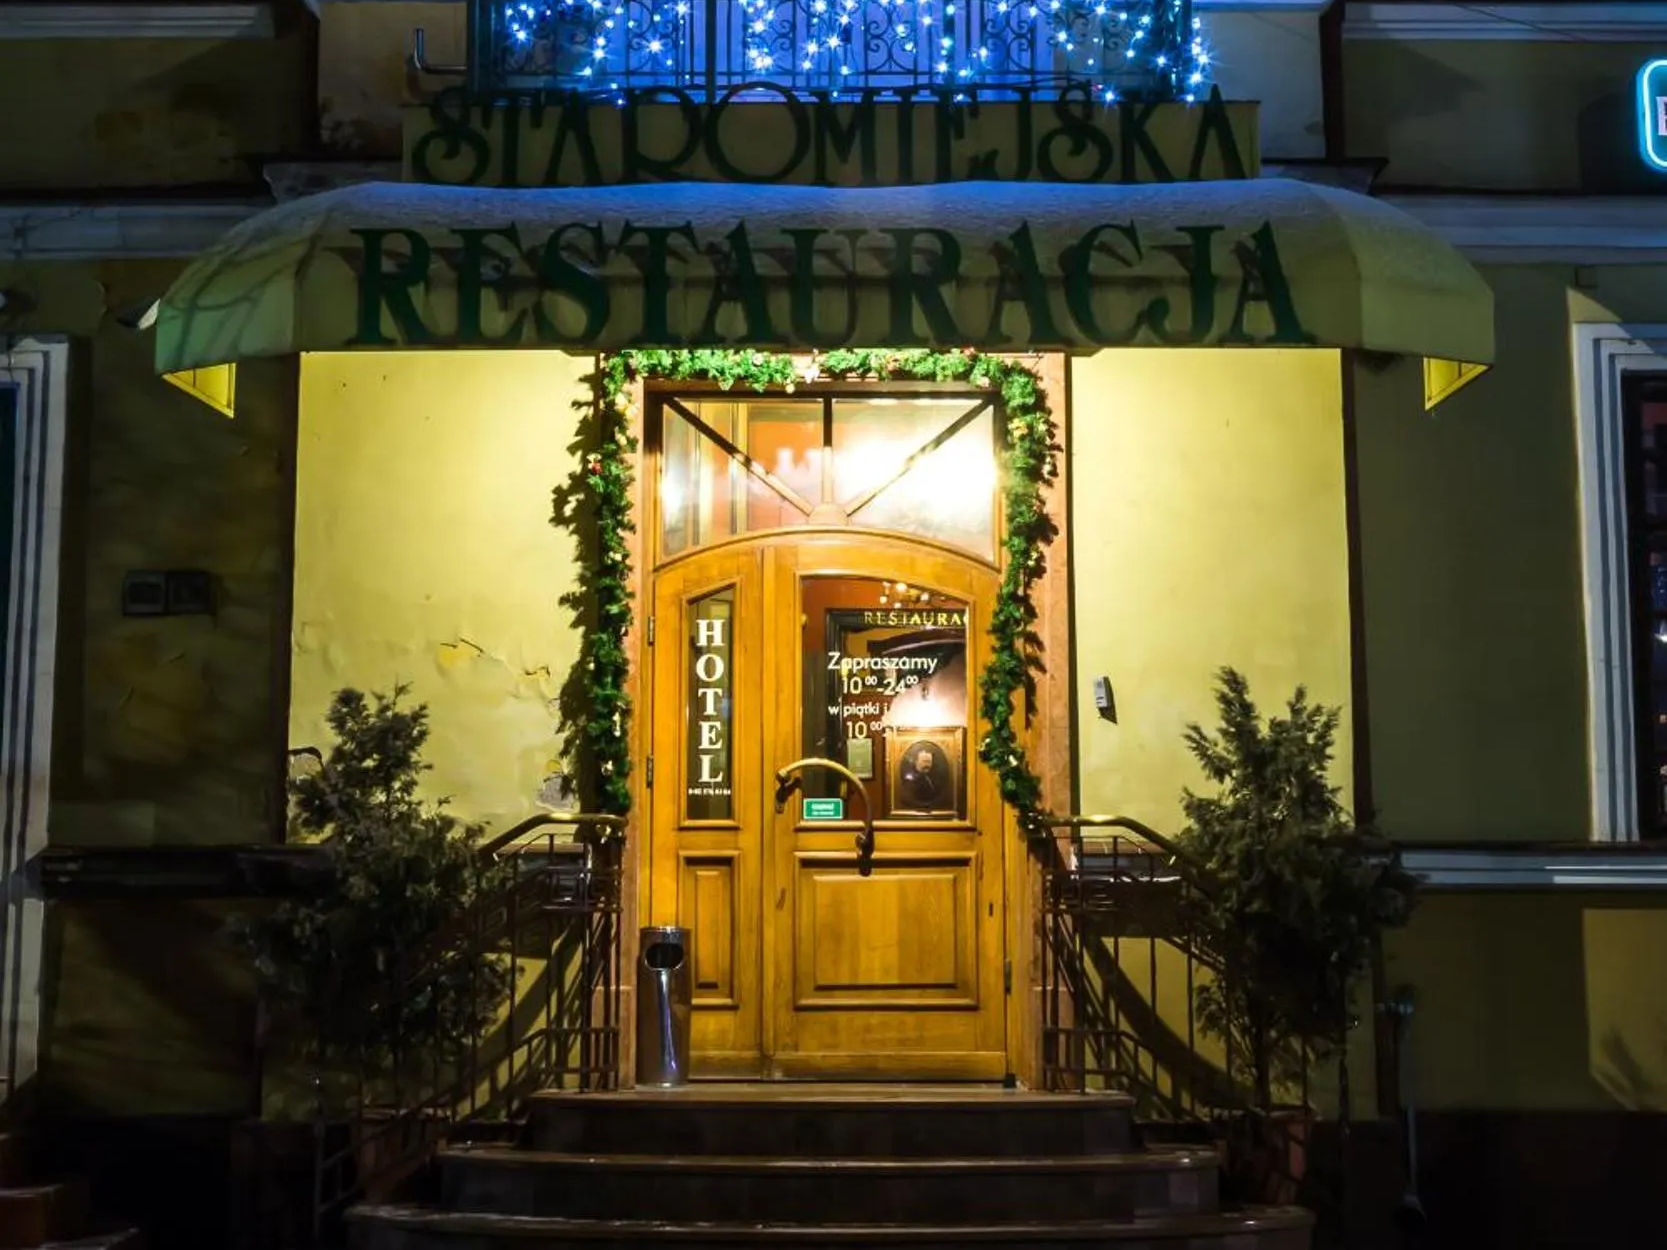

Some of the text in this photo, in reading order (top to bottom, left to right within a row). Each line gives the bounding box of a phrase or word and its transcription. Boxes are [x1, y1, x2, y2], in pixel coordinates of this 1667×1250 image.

[411, 81, 1248, 188] STAROMIEJSKA
[349, 220, 1316, 348] RESTAURACJA
[696, 619, 726, 783] HOTEL
[827, 651, 938, 674] Zapraszamy
[843, 701, 880, 719] piątki
